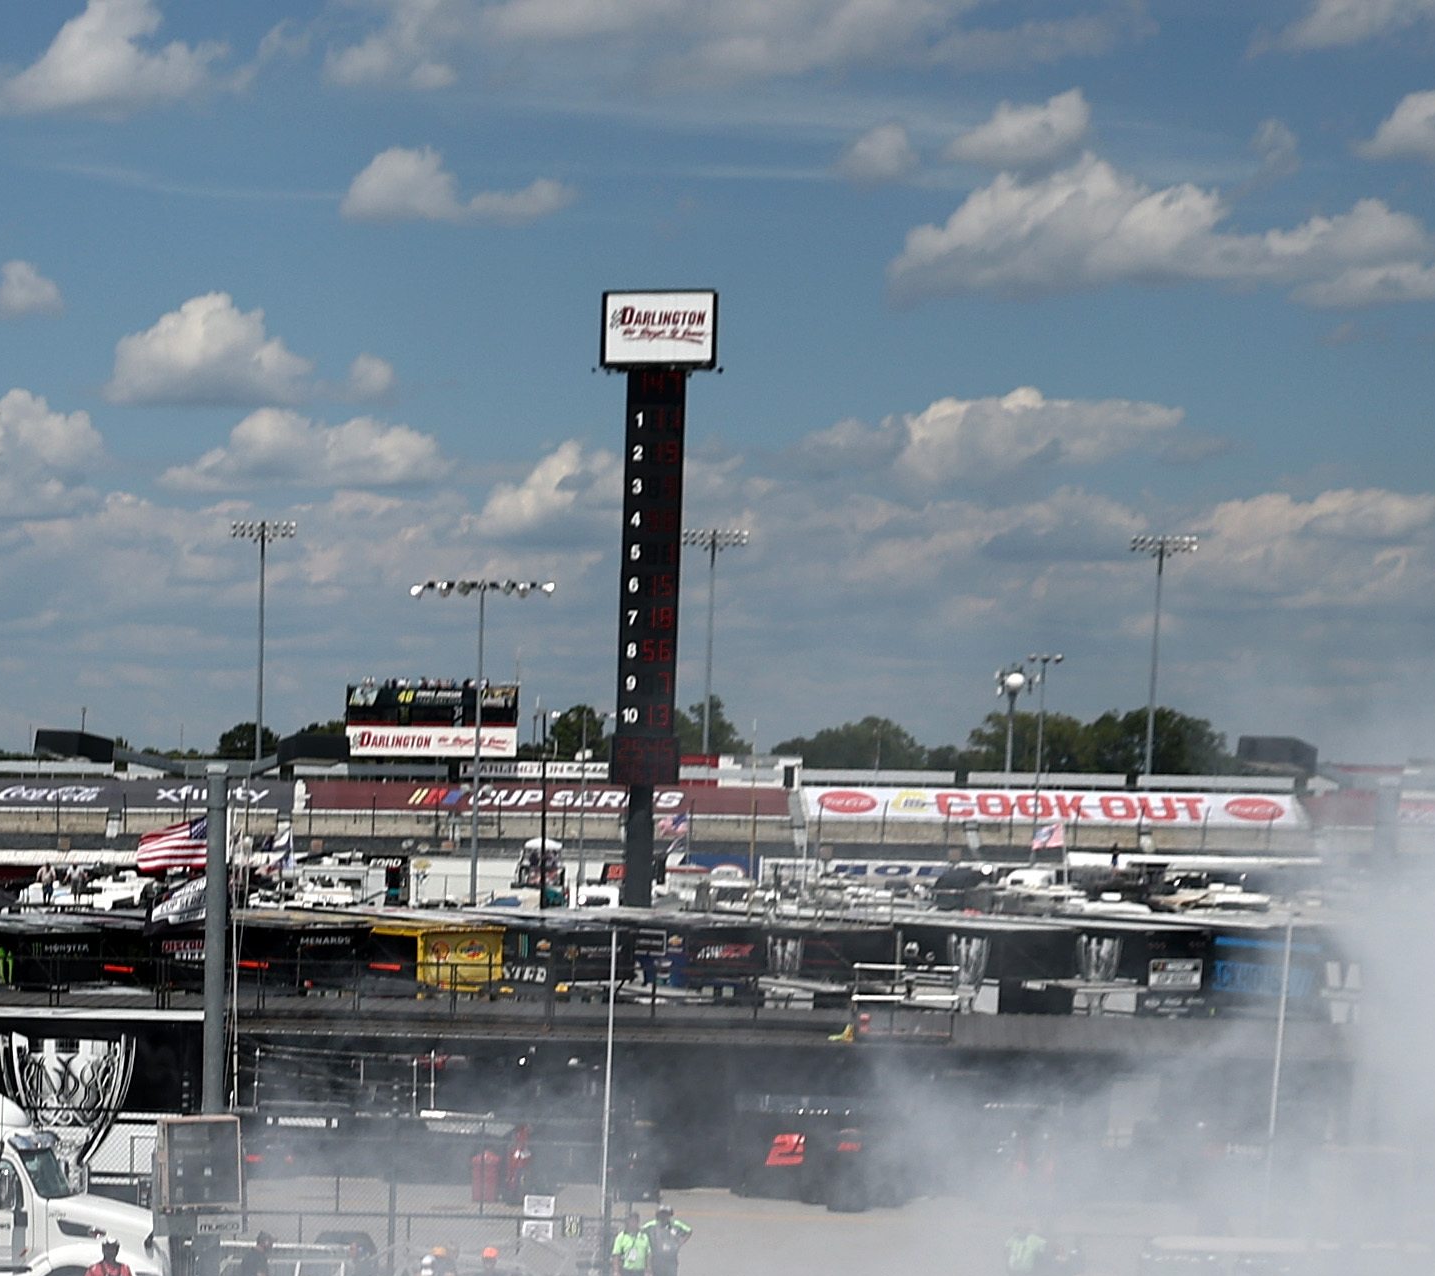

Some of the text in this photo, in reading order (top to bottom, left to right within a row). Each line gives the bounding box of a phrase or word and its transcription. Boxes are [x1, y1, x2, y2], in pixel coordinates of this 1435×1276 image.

[620, 306, 706, 326] DARLINGTON
[634, 411, 643, 428] 1
[632, 445, 643, 461] 2
[631, 478, 642, 495] 3
[630, 511, 641, 528] 4
[629, 544, 640, 561] 5
[628, 577, 639, 594] 6
[627, 610, 637, 626] 7
[626, 643, 637, 659] 8
[625, 671, 672, 695] 9 7
[621, 704, 670, 728] 10 13
[359, 731, 432, 749] DARLINGTON
[468, 789, 685, 808] CUP SERS
[935, 793, 1206, 822] COOK OUT
[369, 857, 402, 868] FORD
[44, 943, 90, 954] MONSTER
[300, 935, 352, 947] MENARDS
[199, 1221, 240, 1232] musco
